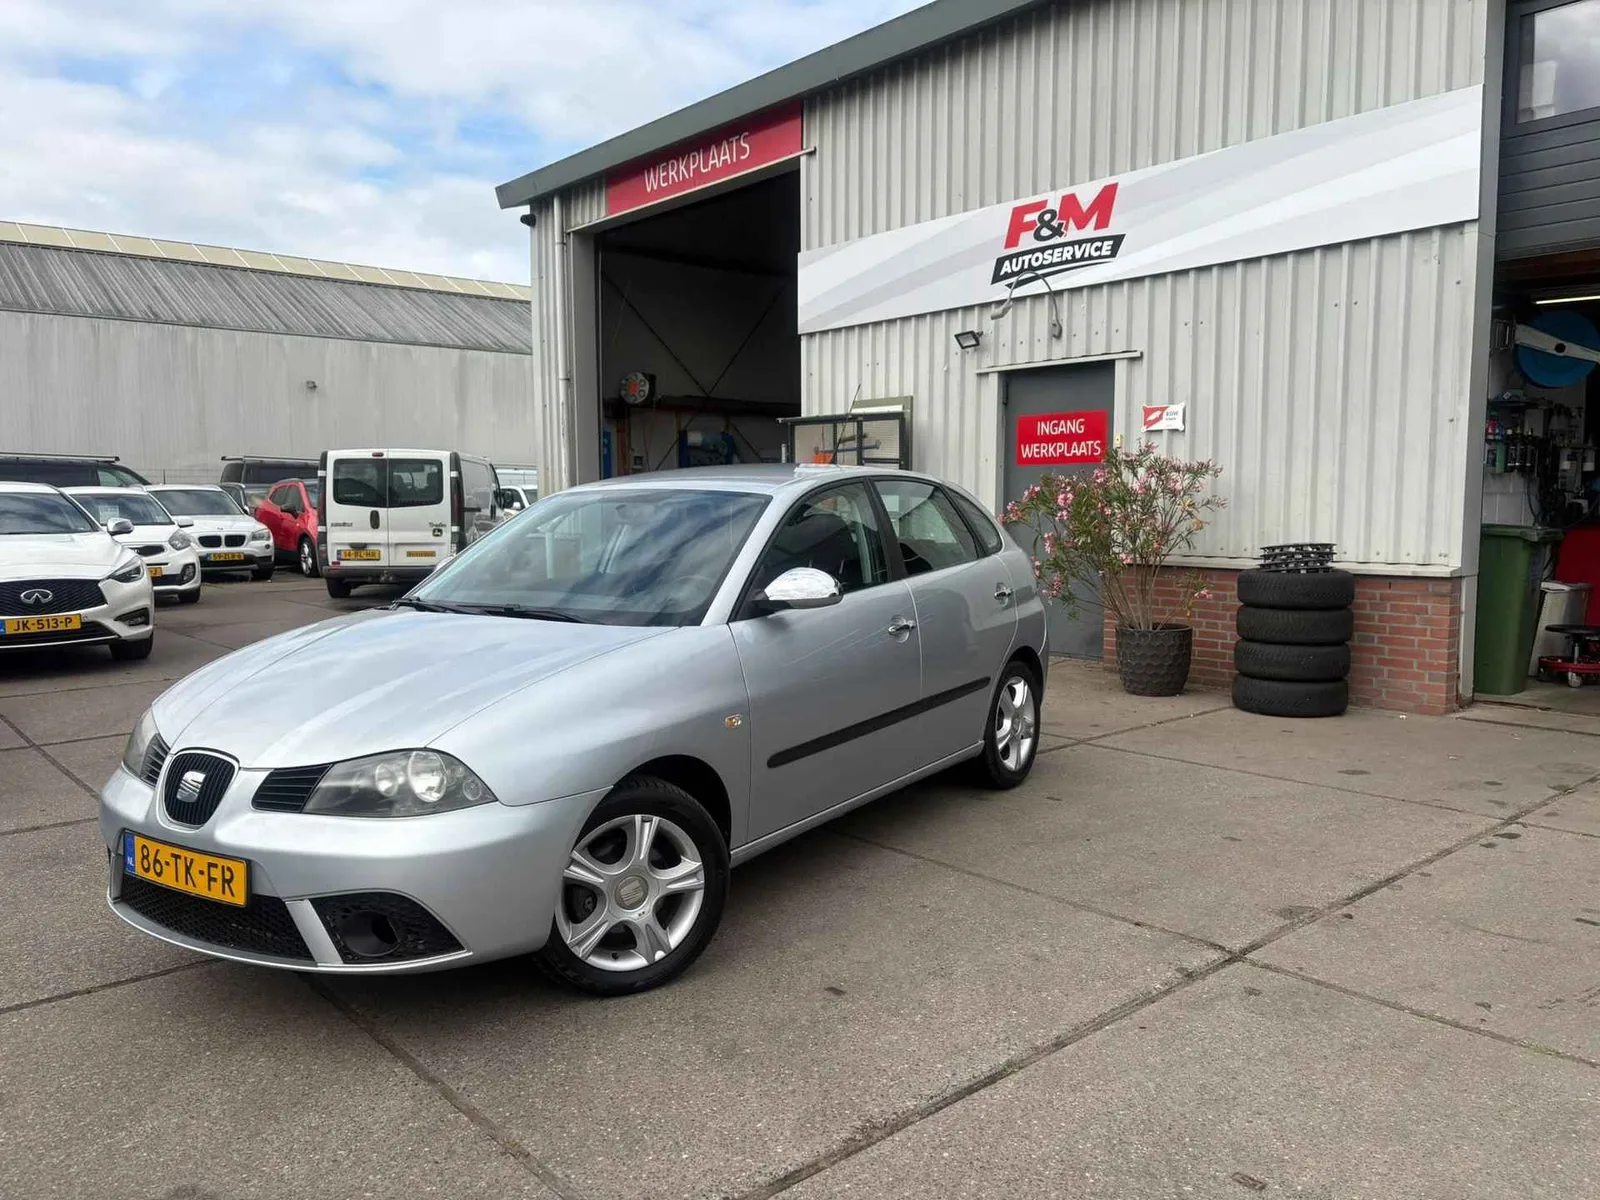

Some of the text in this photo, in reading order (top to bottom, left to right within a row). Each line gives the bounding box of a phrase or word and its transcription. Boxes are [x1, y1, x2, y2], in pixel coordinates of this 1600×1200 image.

[644, 131, 750, 193] WERKPLAATS
[1004, 182, 1119, 250] F&M
[1000, 240, 1114, 275] AUTOSERVICE
[1036, 418, 1085, 436] INGANG
[1020, 440, 1101, 459] WERKPLAATS
[13, 618, 73, 632] JK-513-P
[141, 844, 236, 897] 86-TK-FR
